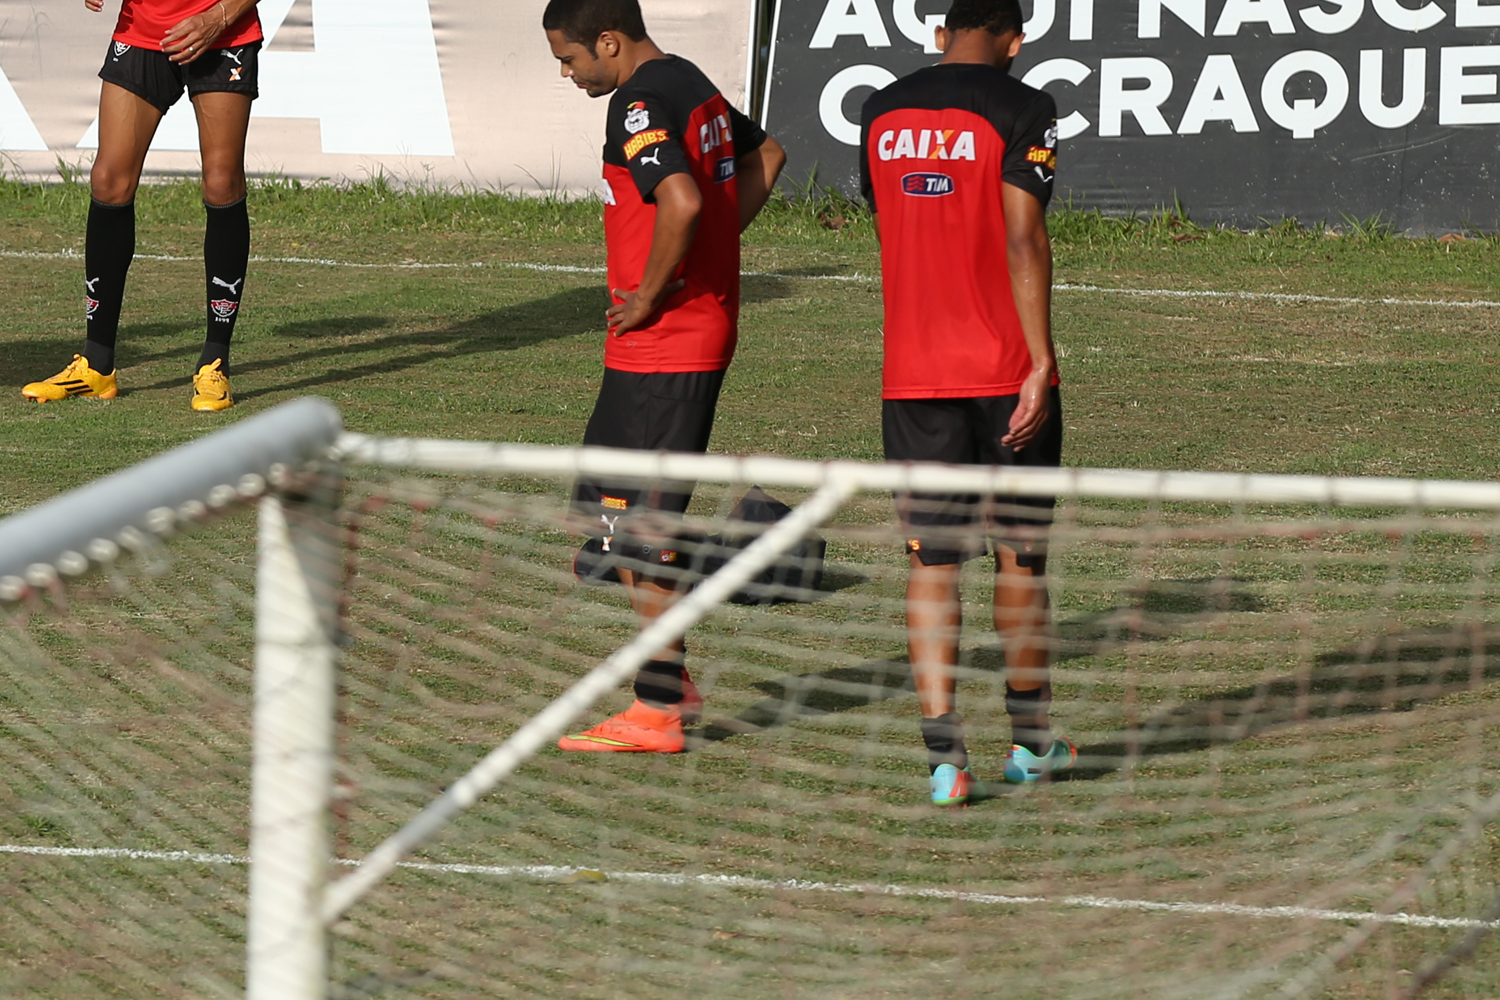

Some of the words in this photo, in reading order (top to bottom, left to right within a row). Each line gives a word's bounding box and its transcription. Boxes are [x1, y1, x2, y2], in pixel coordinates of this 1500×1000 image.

[623, 130, 667, 160] HABIB'S
[877, 128, 976, 161] CAIXA
[926, 177, 949, 192] TIM
